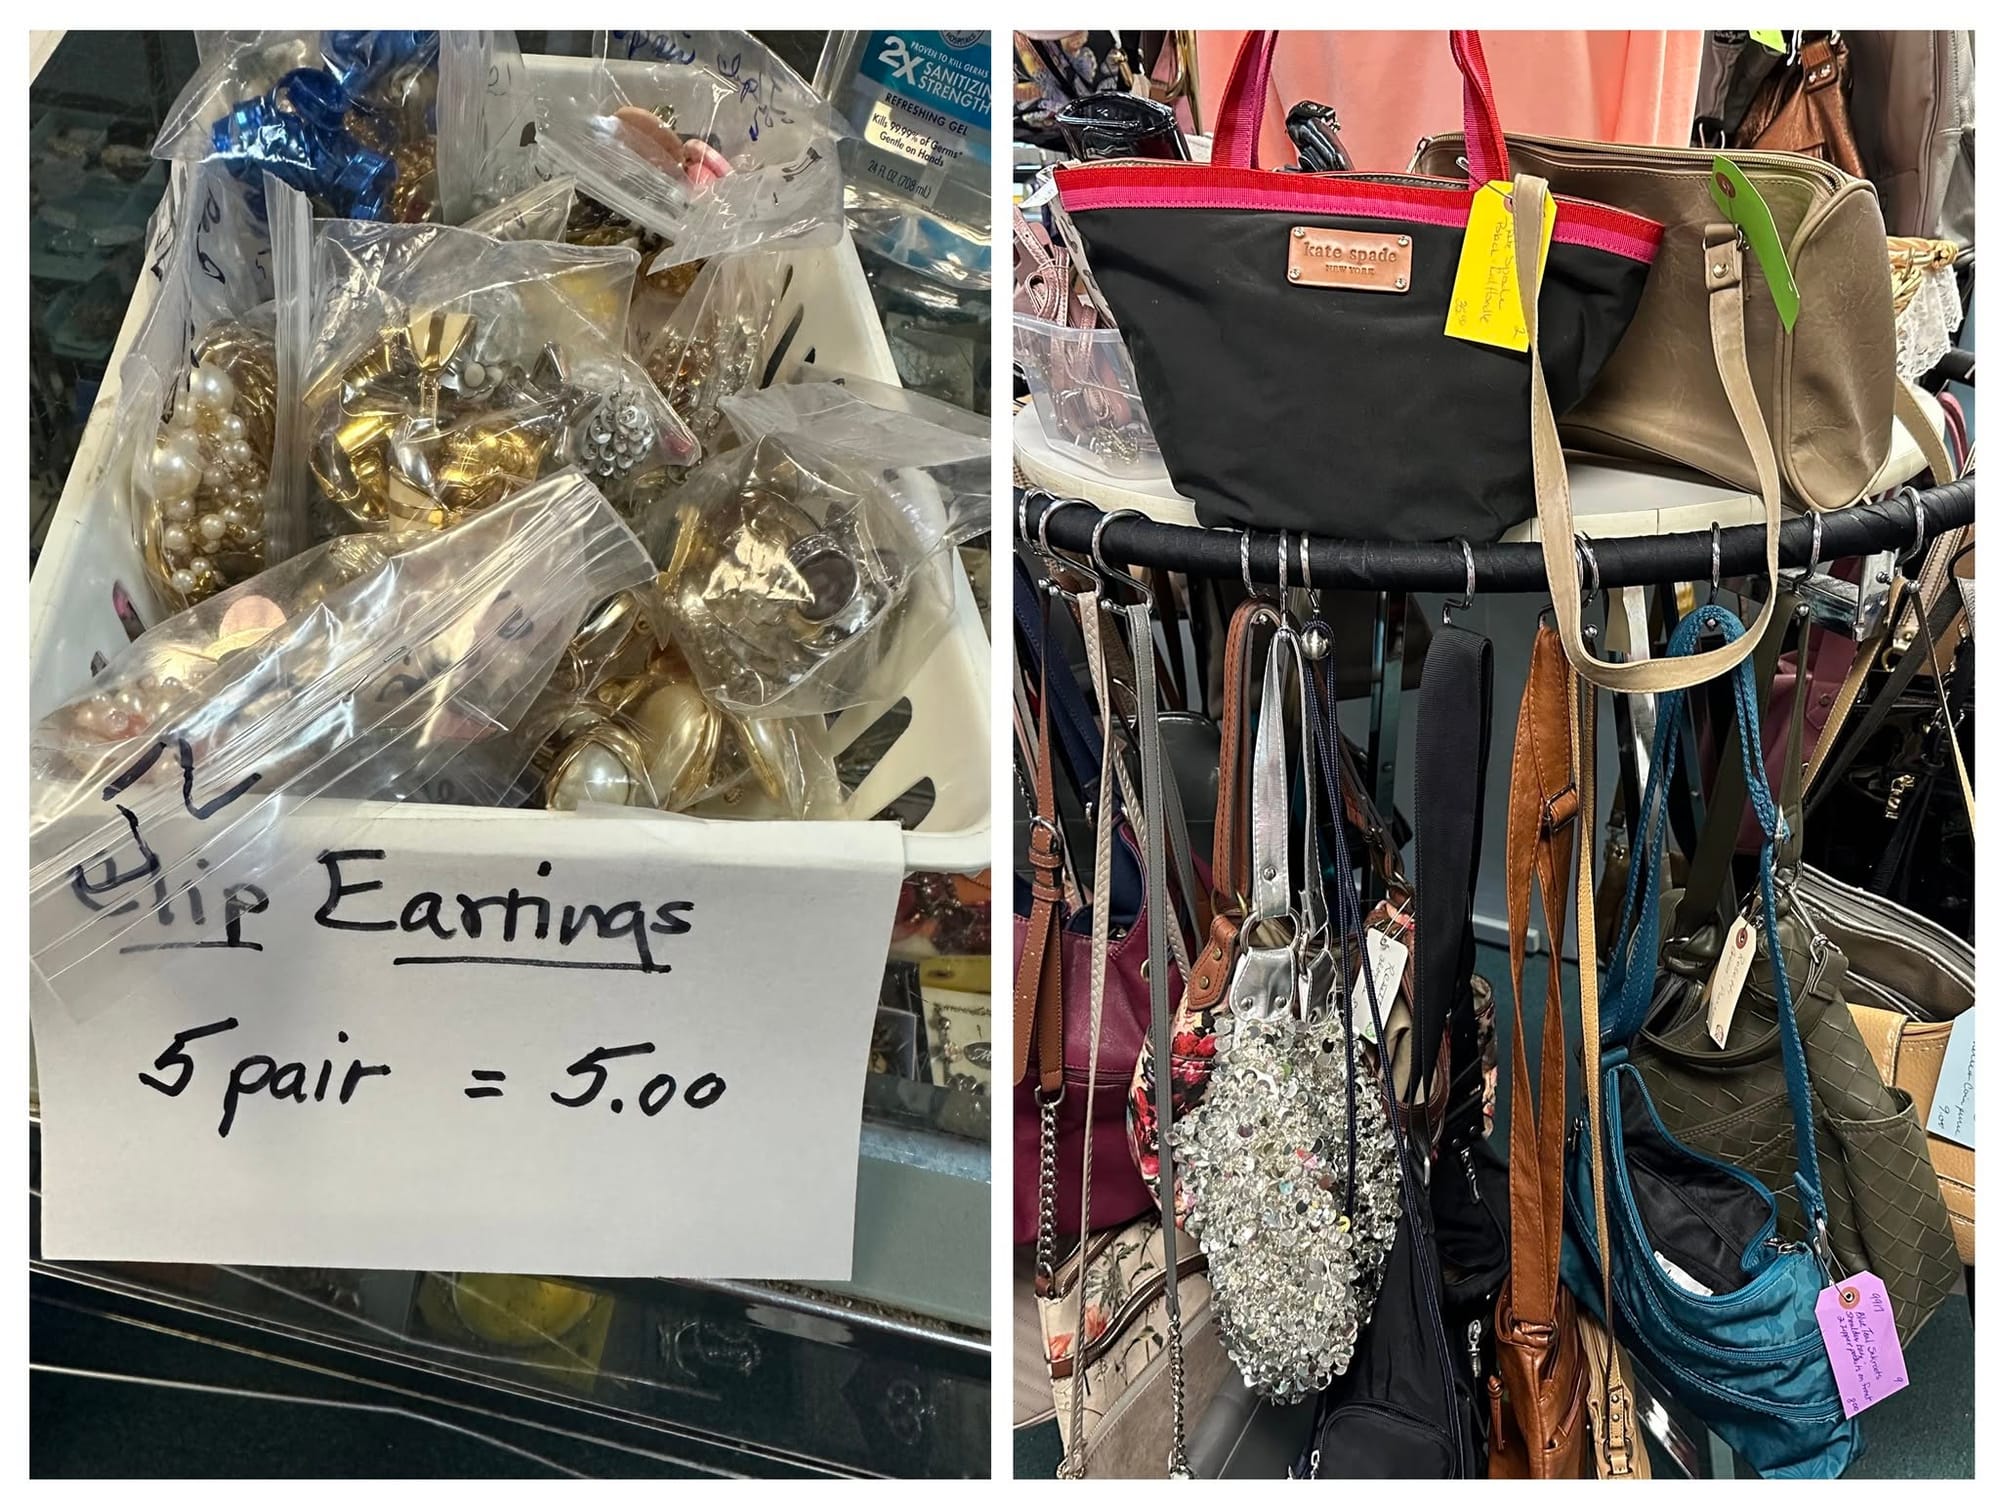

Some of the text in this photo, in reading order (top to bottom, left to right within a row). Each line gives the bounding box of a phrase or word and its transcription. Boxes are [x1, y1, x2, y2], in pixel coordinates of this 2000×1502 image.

[878, 36, 924, 86] 2X
[911, 41, 989, 78] PROVEN TO KILL GERMS
[918, 75, 991, 115] STRENGTH
[872, 112, 888, 128] Kills
[920, 136, 931, 147] of
[885, 92, 968, 136] REFRESHING GEL
[867, 160, 878, 173] 24
[880, 130, 944, 167] Gentle on Hands
[1304, 241, 1397, 265] kate spade
[1325, 264, 1376, 276] NEW YORK
[139, 1017, 239, 1097] 5
[213, 1031, 392, 1138] pair
[550, 1042, 727, 1117] 5.00
